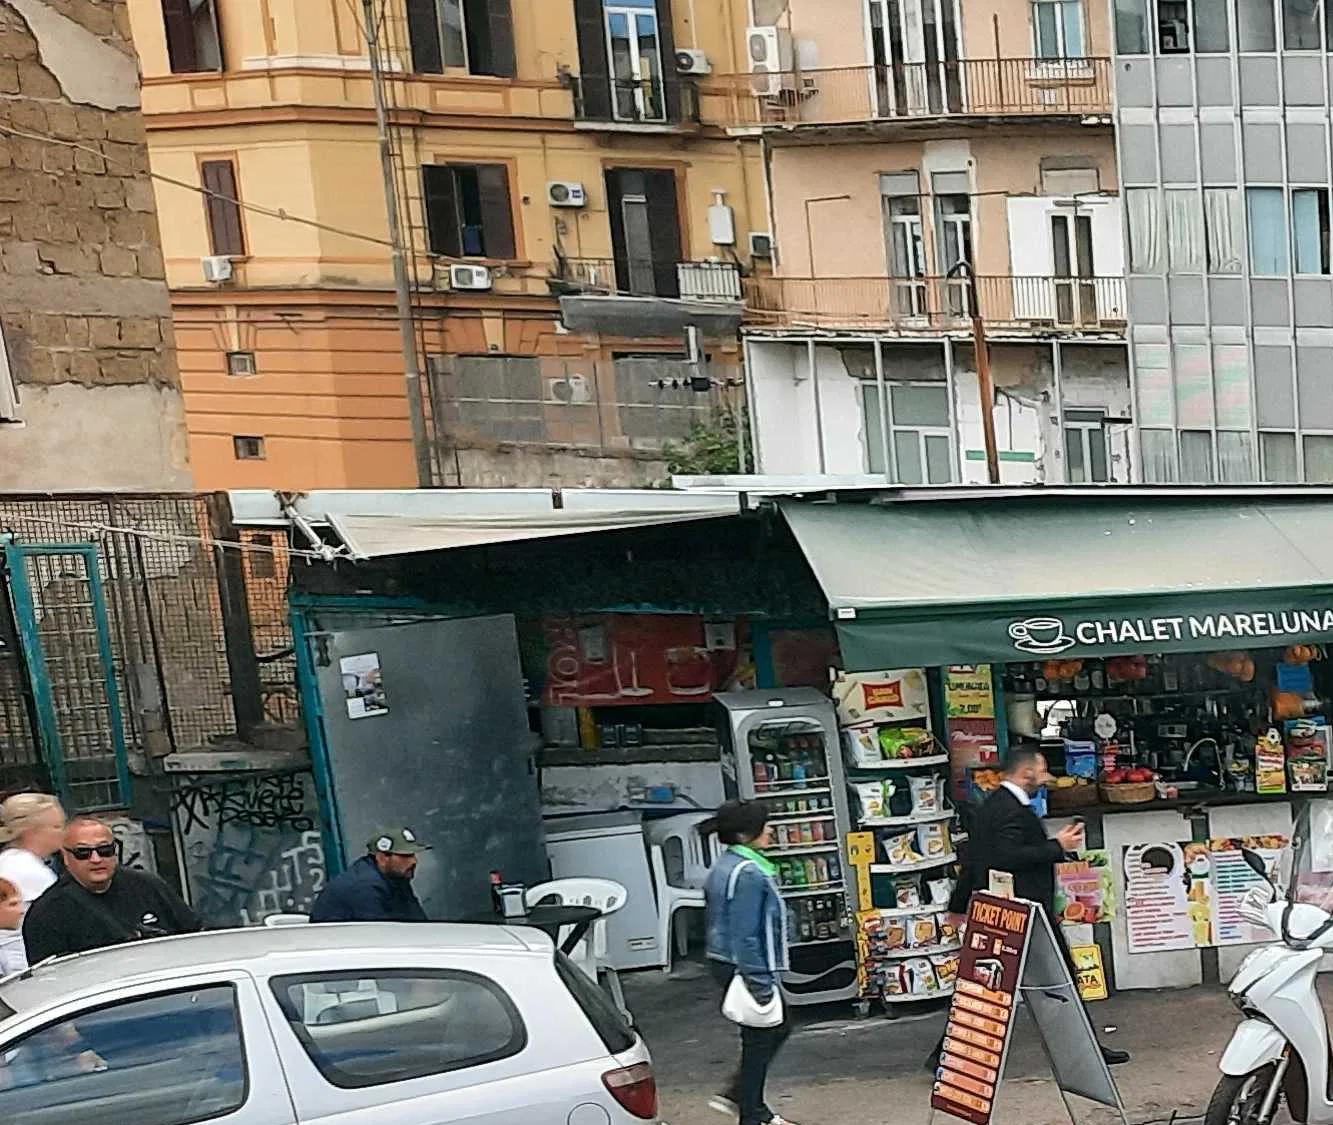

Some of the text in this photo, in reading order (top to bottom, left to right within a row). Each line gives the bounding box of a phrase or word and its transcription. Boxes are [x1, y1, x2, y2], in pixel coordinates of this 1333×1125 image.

[1077, 618, 1184, 644] CHALET
[972, 901, 1027, 933] TICKET POINT
